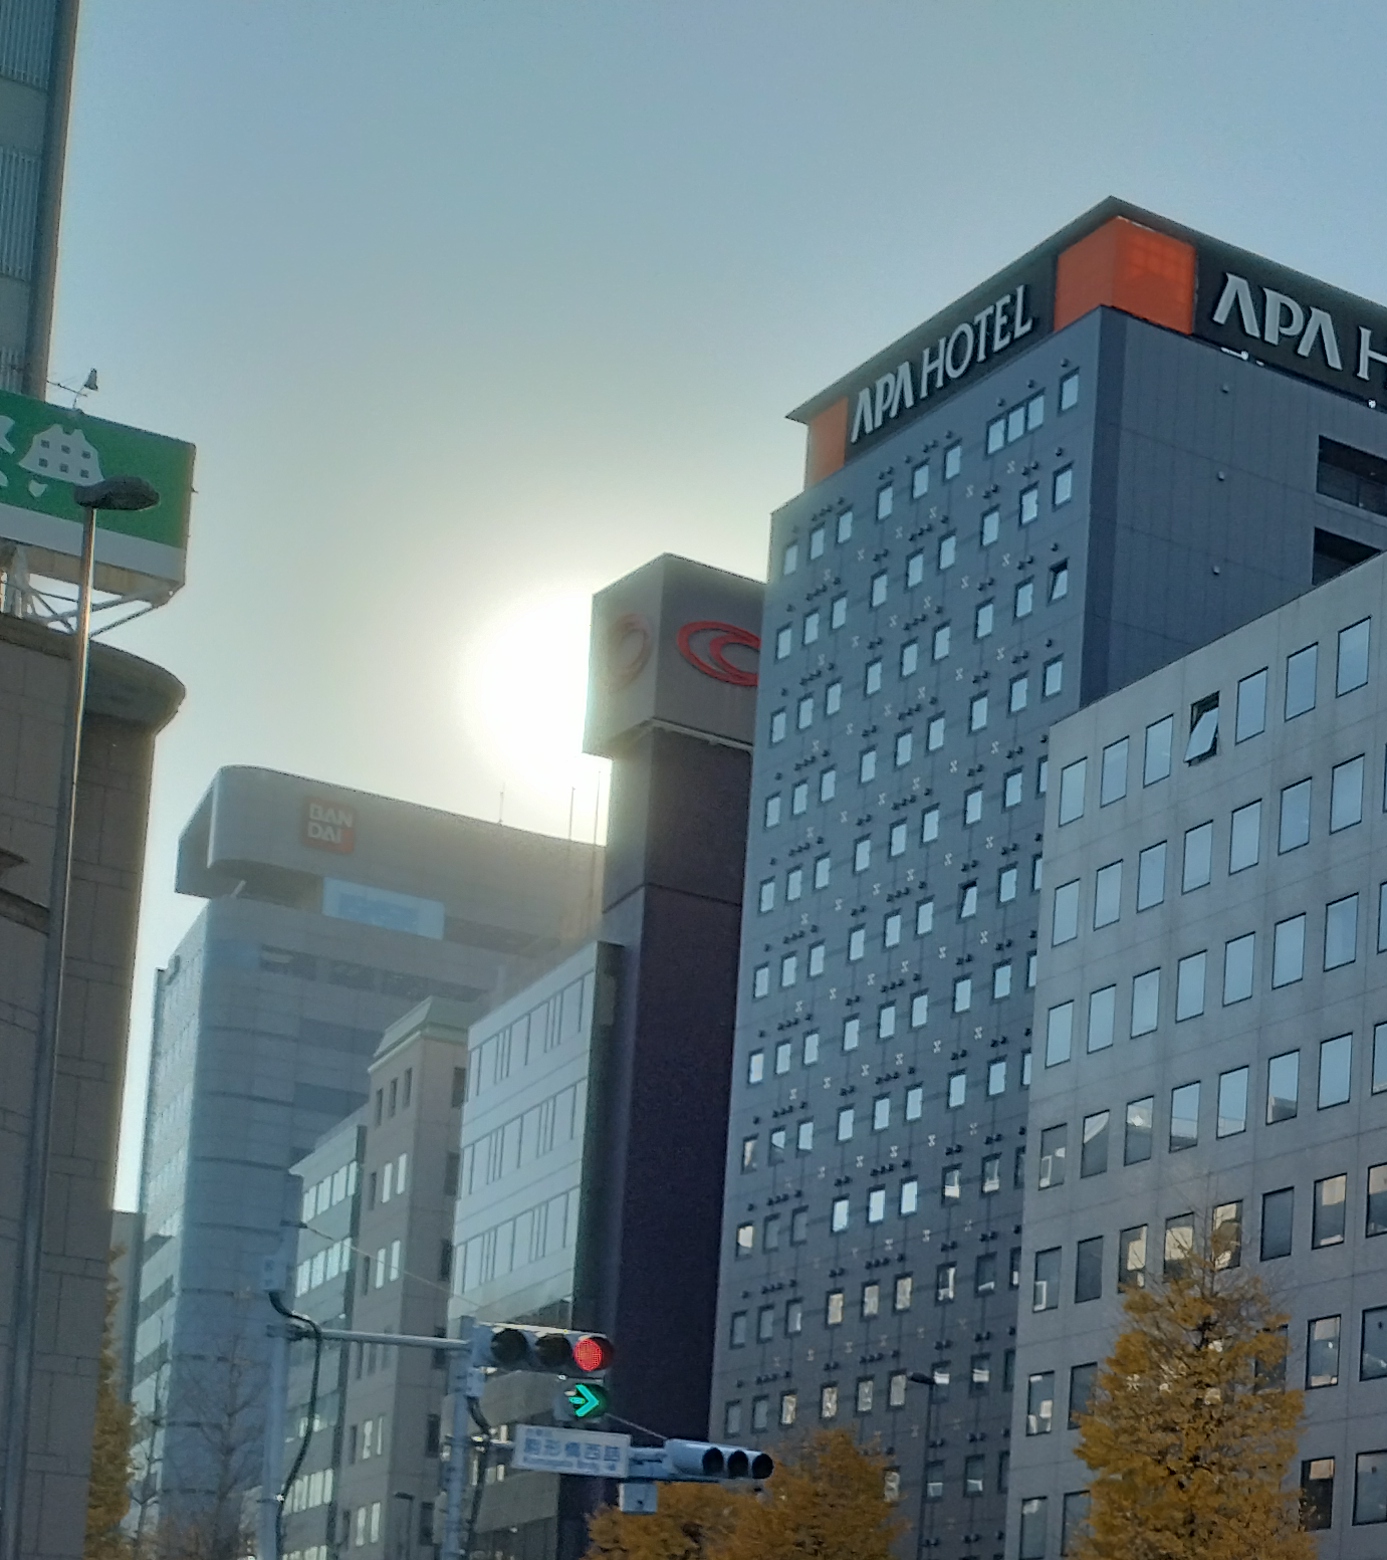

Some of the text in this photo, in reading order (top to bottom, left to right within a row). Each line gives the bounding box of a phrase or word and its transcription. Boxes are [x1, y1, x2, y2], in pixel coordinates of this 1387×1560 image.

[1213, 272, 1343, 371] APA
[851, 285, 1034, 443] APA HOTEL
[308, 821, 341, 844] DAI
[309, 803, 353, 828] BAN
